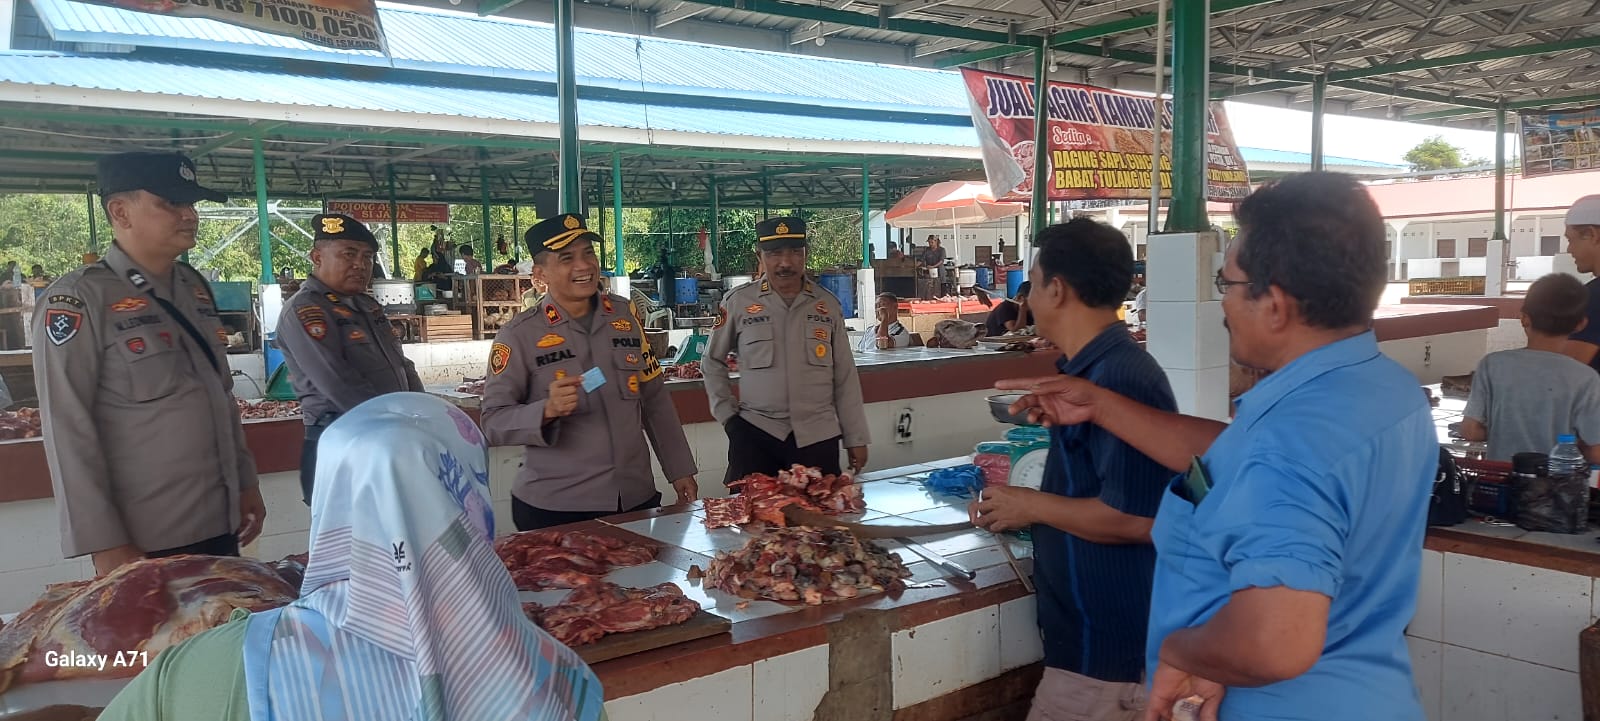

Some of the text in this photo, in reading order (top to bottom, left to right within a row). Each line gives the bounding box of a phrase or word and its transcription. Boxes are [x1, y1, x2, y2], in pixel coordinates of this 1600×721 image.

[985, 78, 1034, 117] JUAL
[1028, 83, 1099, 124] AGING
[1053, 150, 1098, 168] DAGING
[1055, 170, 1097, 188] BABAT,
[1097, 170, 1139, 188] TULANG
[536, 349, 576, 367] RIZAL
